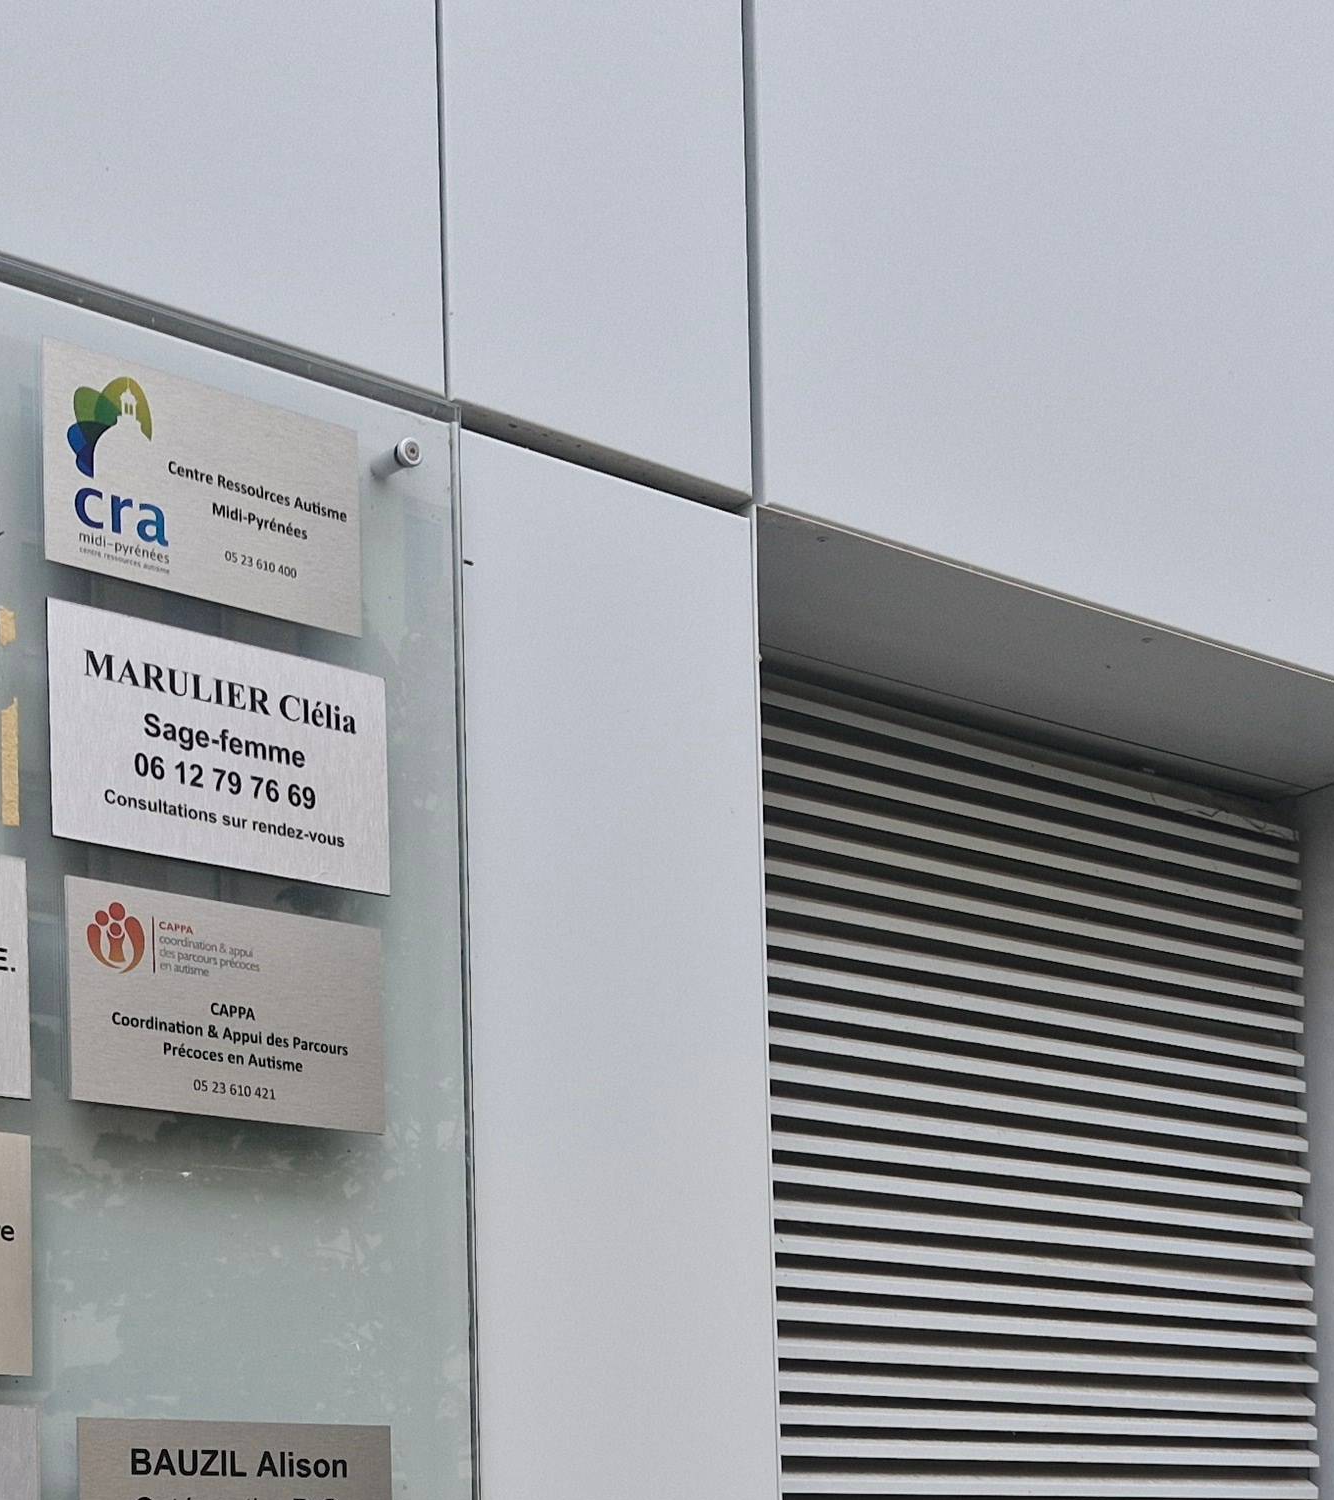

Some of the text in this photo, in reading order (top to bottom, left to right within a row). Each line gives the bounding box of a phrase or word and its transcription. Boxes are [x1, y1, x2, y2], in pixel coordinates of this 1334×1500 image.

[169, 461, 347, 522] Centre Ressources Autisme
[74, 488, 168, 547] cra
[212, 502, 307, 540] Midi-Pyrénées
[79, 532, 169, 564] midi-pyrénées
[225, 551, 297, 578] 05 23 610 400
[85, 650, 356, 734] MARULIER Clélia
[144, 713, 306, 768] Sage-femme
[135, 753, 315, 809] 06 12 79 76 69
[105, 789, 344, 847] Consultations sur rendez-vous
[159, 921, 193, 935] CAPPA
[159, 936, 217, 953] coordination
[229, 947, 253, 959] appui
[159, 947, 260, 972] des parcours précoces
[160, 962, 209, 977] en autisme
[211, 1003, 255, 1021] CAPPA
[112, 1012, 348, 1056] Coordination & Appui des Parcours
[164, 1042, 302, 1072] Précoces en Autisme
[194, 1079, 275, 1100] 05 23 610 421
[131, 1448, 347, 1478] BAUZIL Alison
